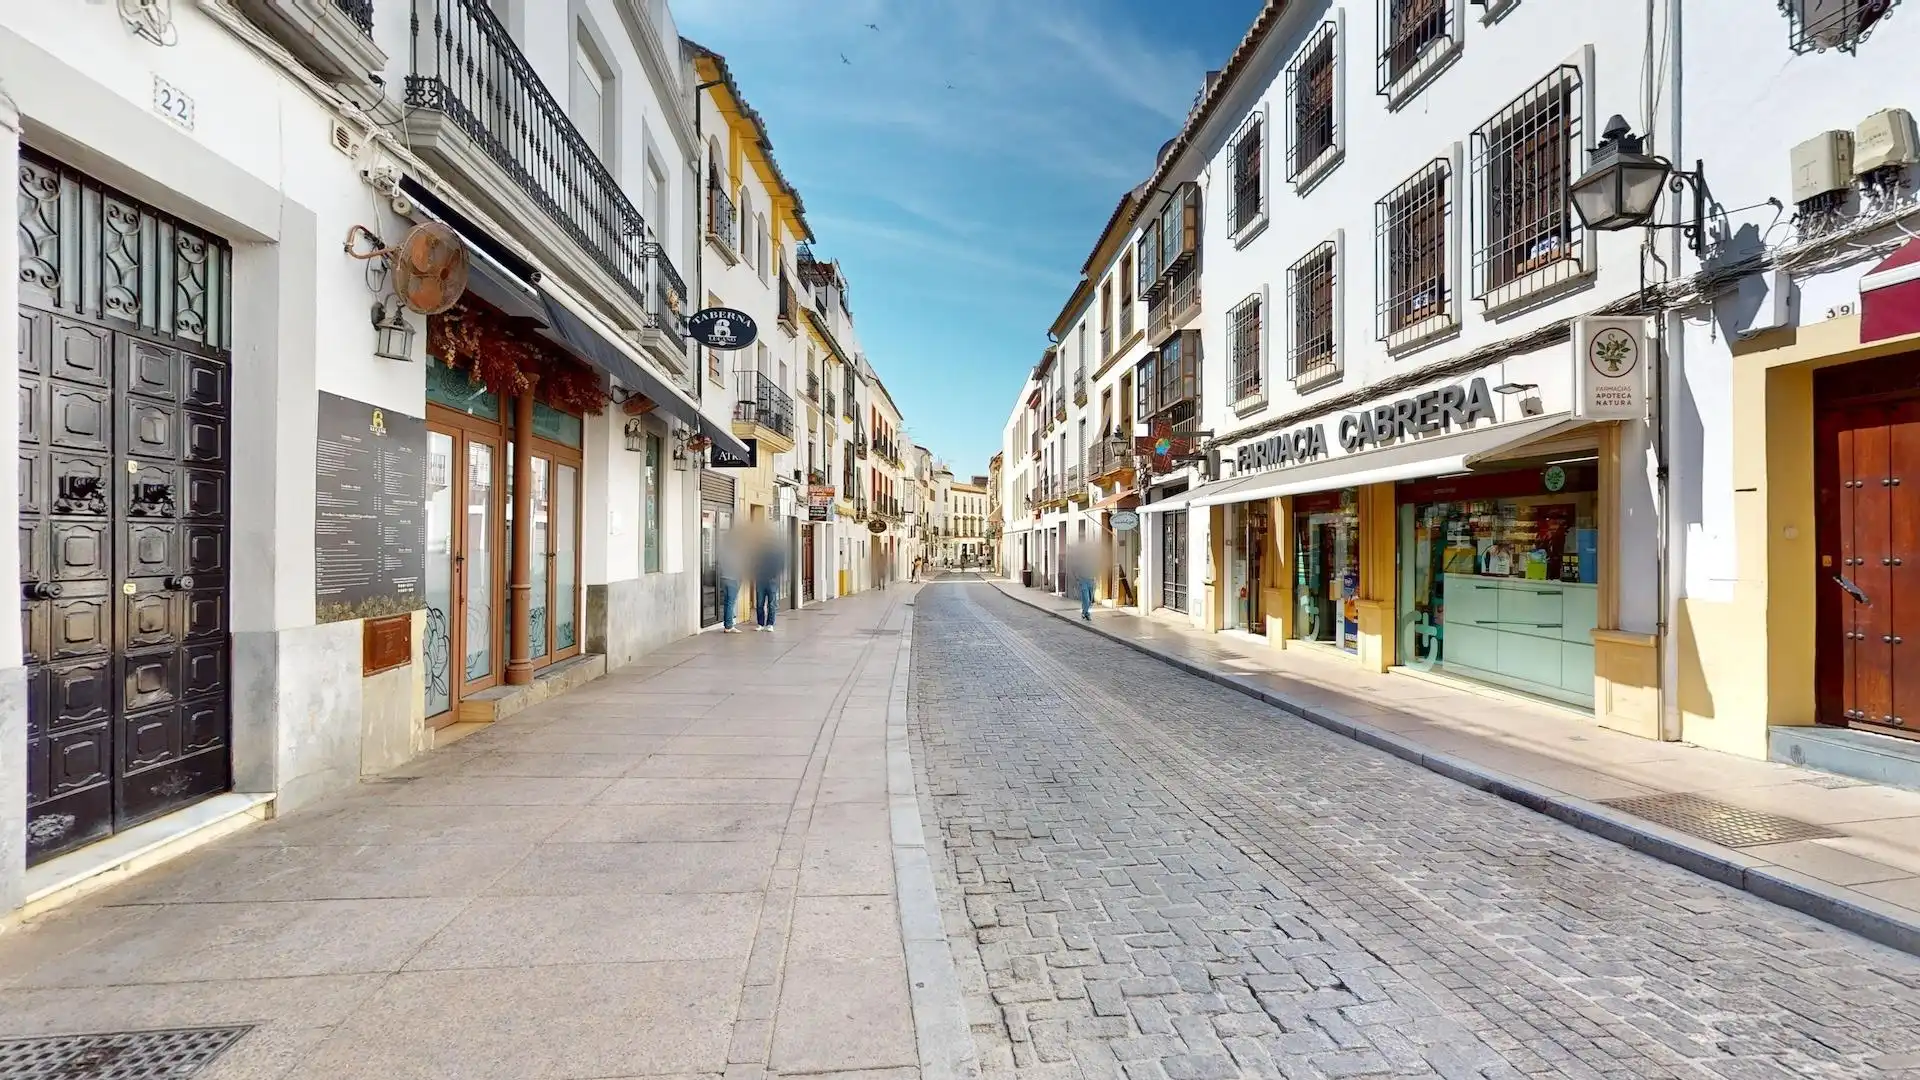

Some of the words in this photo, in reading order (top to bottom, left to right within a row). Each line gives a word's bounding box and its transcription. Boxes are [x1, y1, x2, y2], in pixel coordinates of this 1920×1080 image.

[161, 89, 187, 120] 22
[692, 311, 751, 328] TABERNA
[713, 319, 731, 337] 6
[1237, 423, 1328, 472] FARMACIA
[1339, 377, 1497, 453] CABRERA
